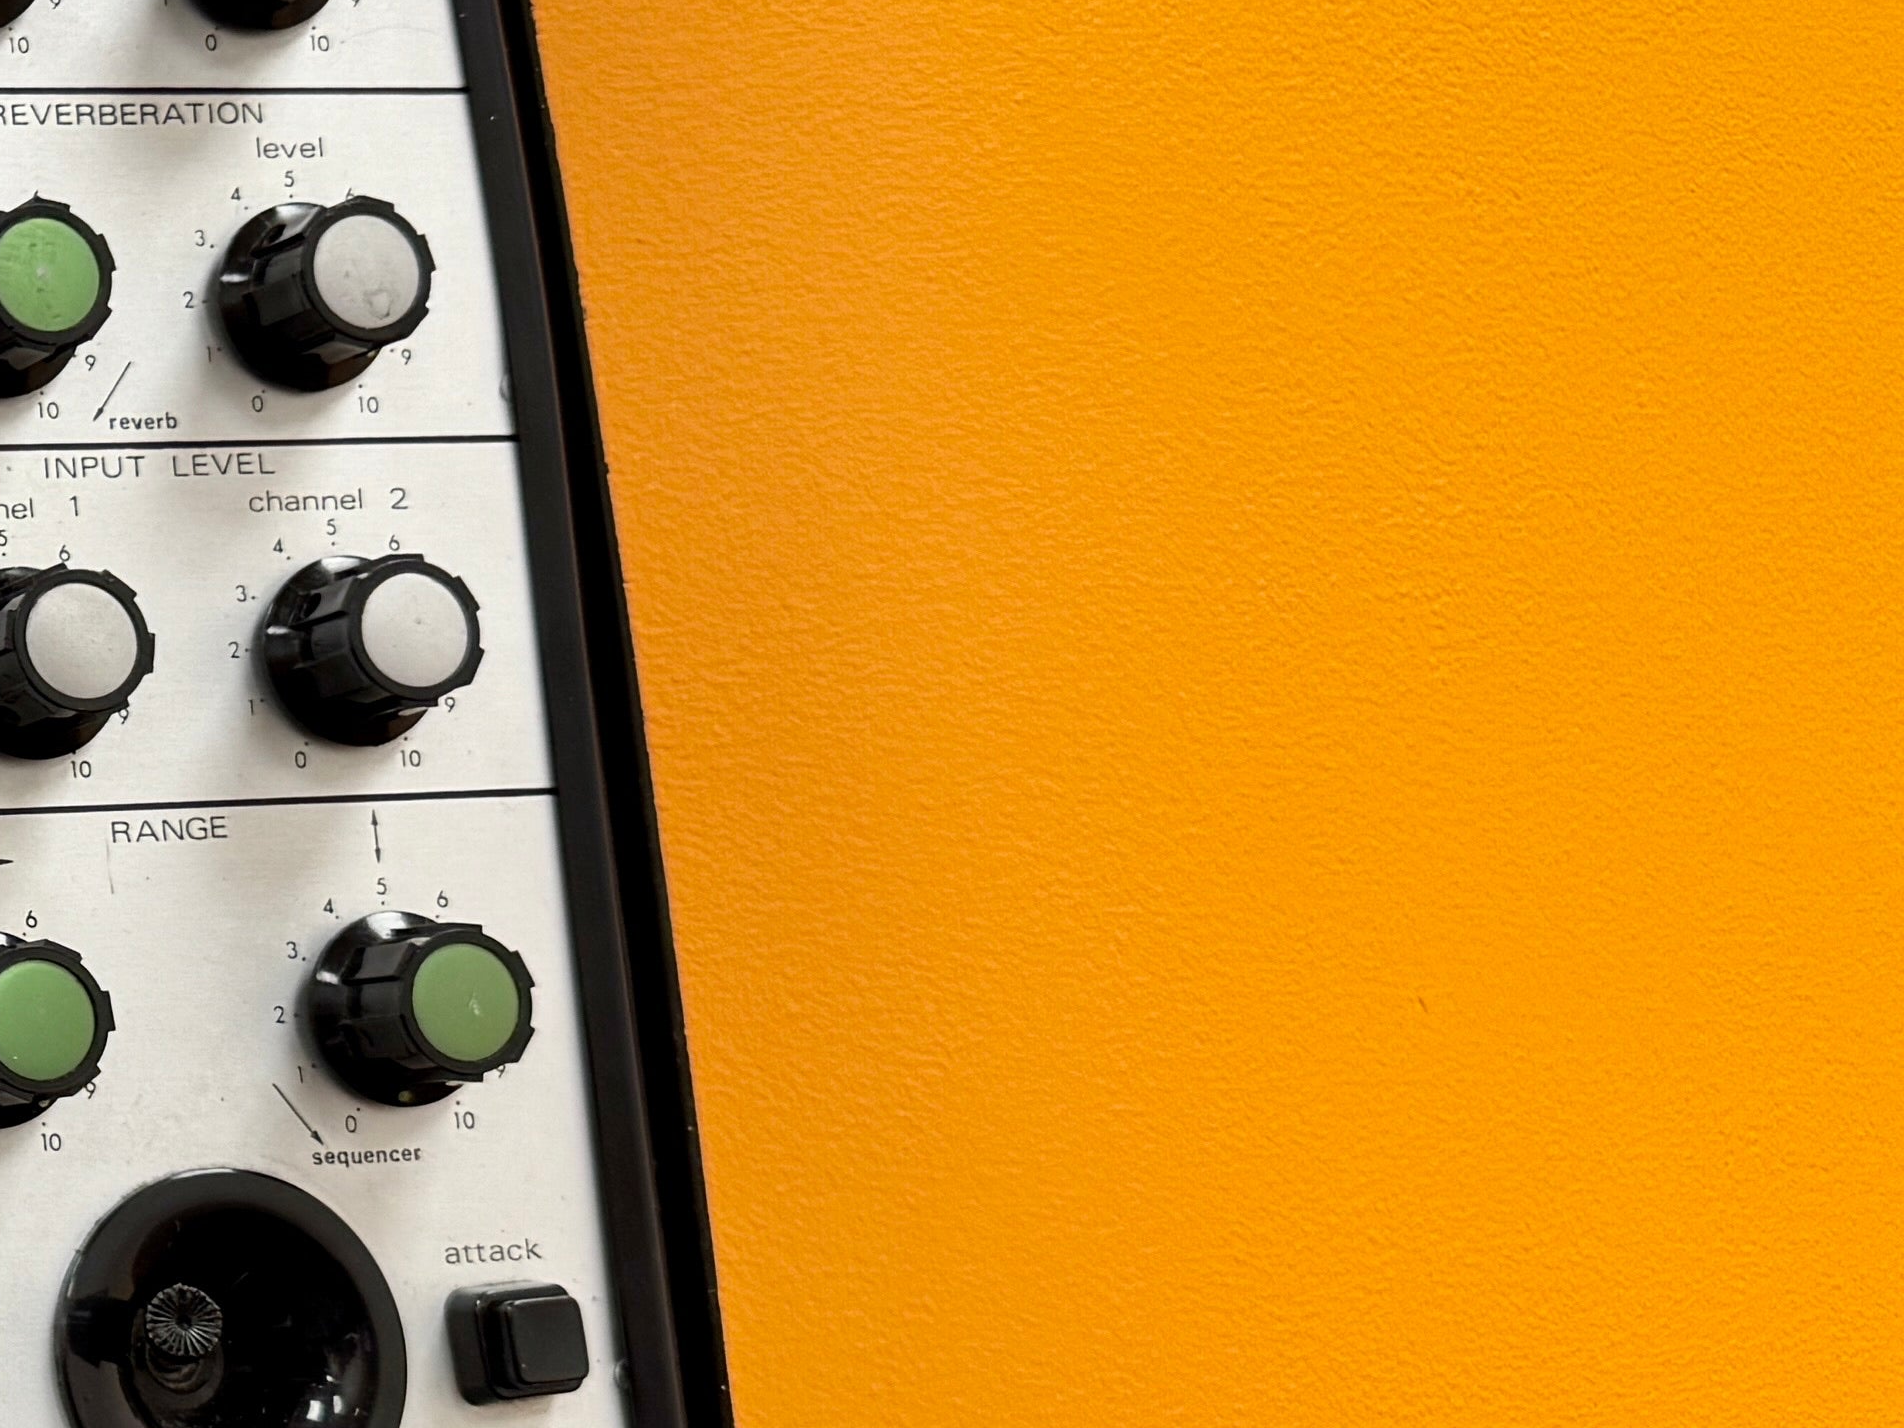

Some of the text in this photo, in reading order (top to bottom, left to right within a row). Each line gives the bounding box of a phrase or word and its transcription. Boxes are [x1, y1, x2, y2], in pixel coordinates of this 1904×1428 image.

[254, 135, 325, 160] level
[108, 410, 180, 432] reverb
[42, 451, 277, 480] INPUT LEVEL
[68, 494, 80, 518] 1
[247, 486, 410, 515] channel 2
[109, 814, 230, 845] RANGE
[310, 1146, 422, 1170] sequencer
[443, 1236, 544, 1266] attack
